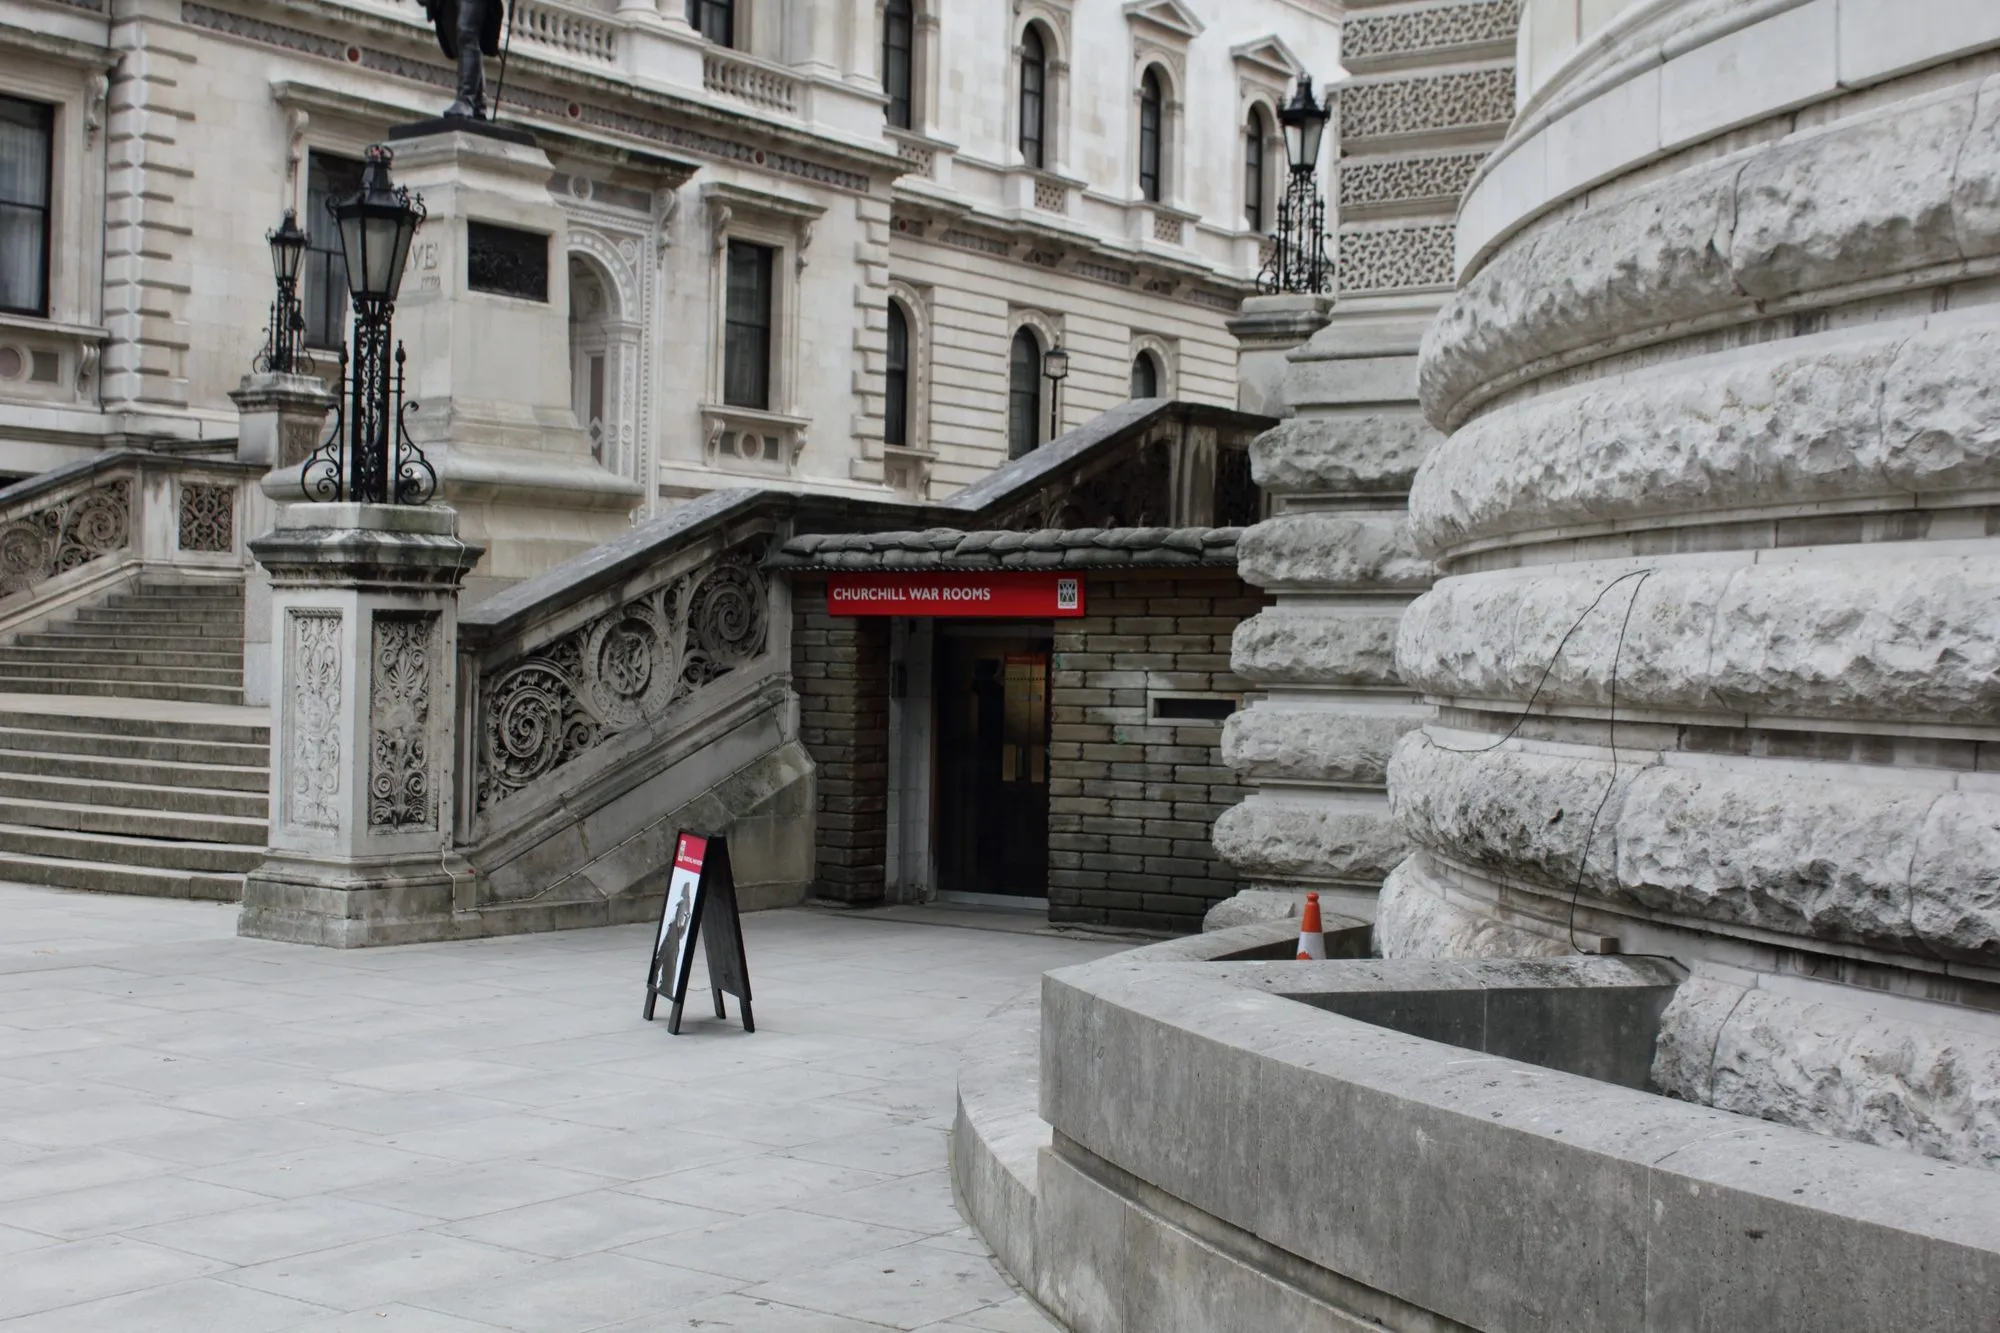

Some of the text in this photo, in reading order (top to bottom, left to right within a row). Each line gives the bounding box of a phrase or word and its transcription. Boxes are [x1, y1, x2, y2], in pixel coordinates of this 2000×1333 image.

[833, 587, 991, 600] CHURCHILL WAR ROOMS
